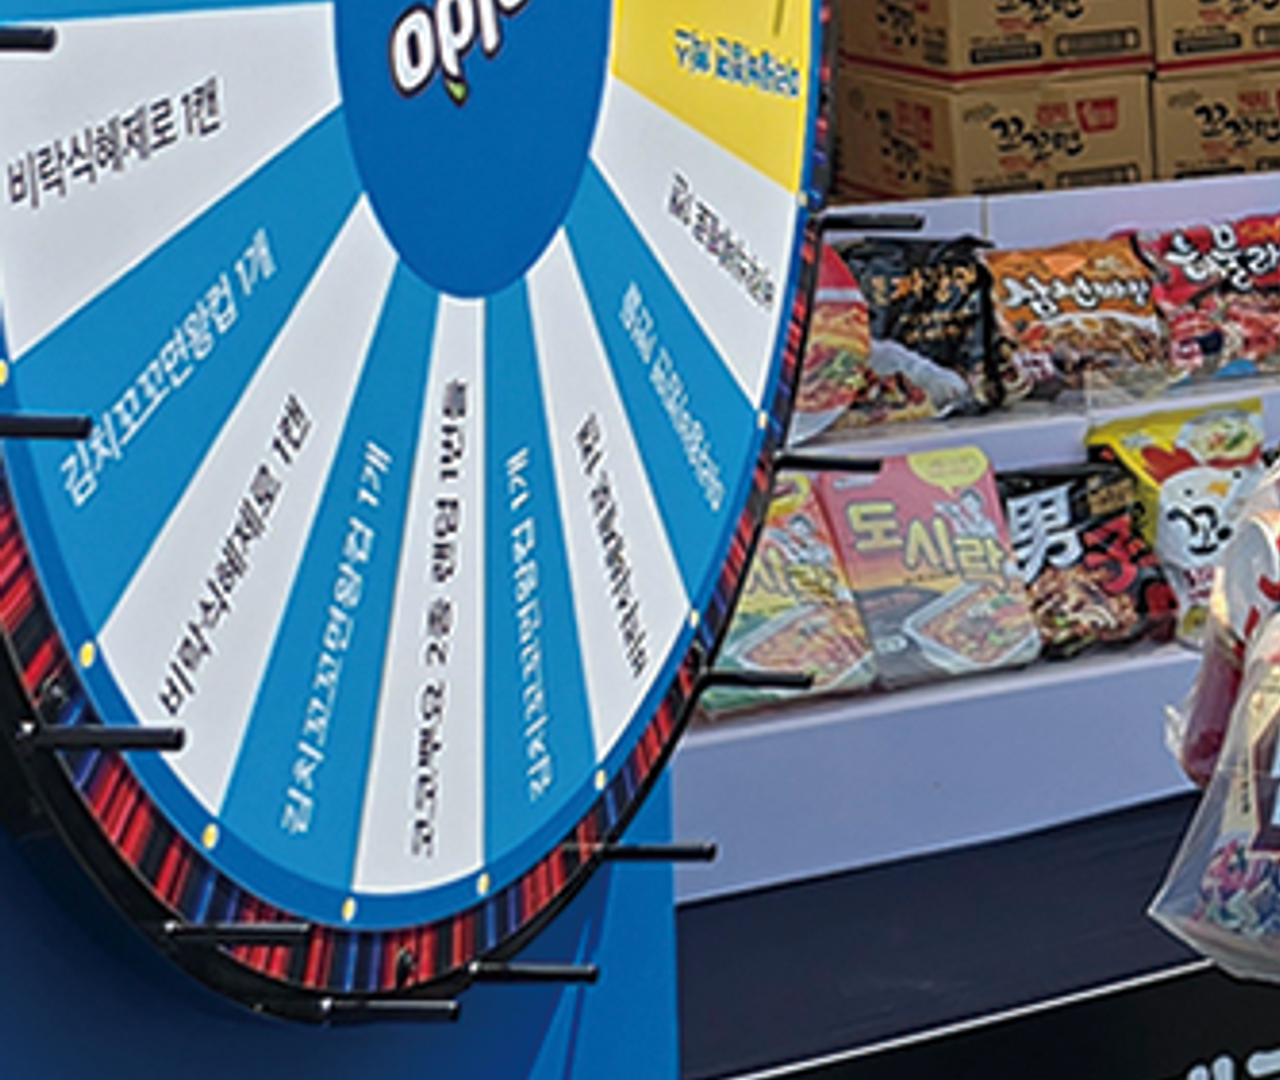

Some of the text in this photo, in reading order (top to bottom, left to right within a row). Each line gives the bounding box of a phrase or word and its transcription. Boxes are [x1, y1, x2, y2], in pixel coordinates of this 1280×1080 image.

[8, 77, 221, 207] 비락식혜제로 1캔
[60, 227, 276, 506] 김치꼬꼬면왕컵 1개
[160, 395, 308, 719] 비락식혜제로 1캔
[505, 446, 530, 511] 1개
[846, 501, 1010, 590] 도시락
[281, 440, 392, 833] 김치꼬꼬면왕컵 1개
